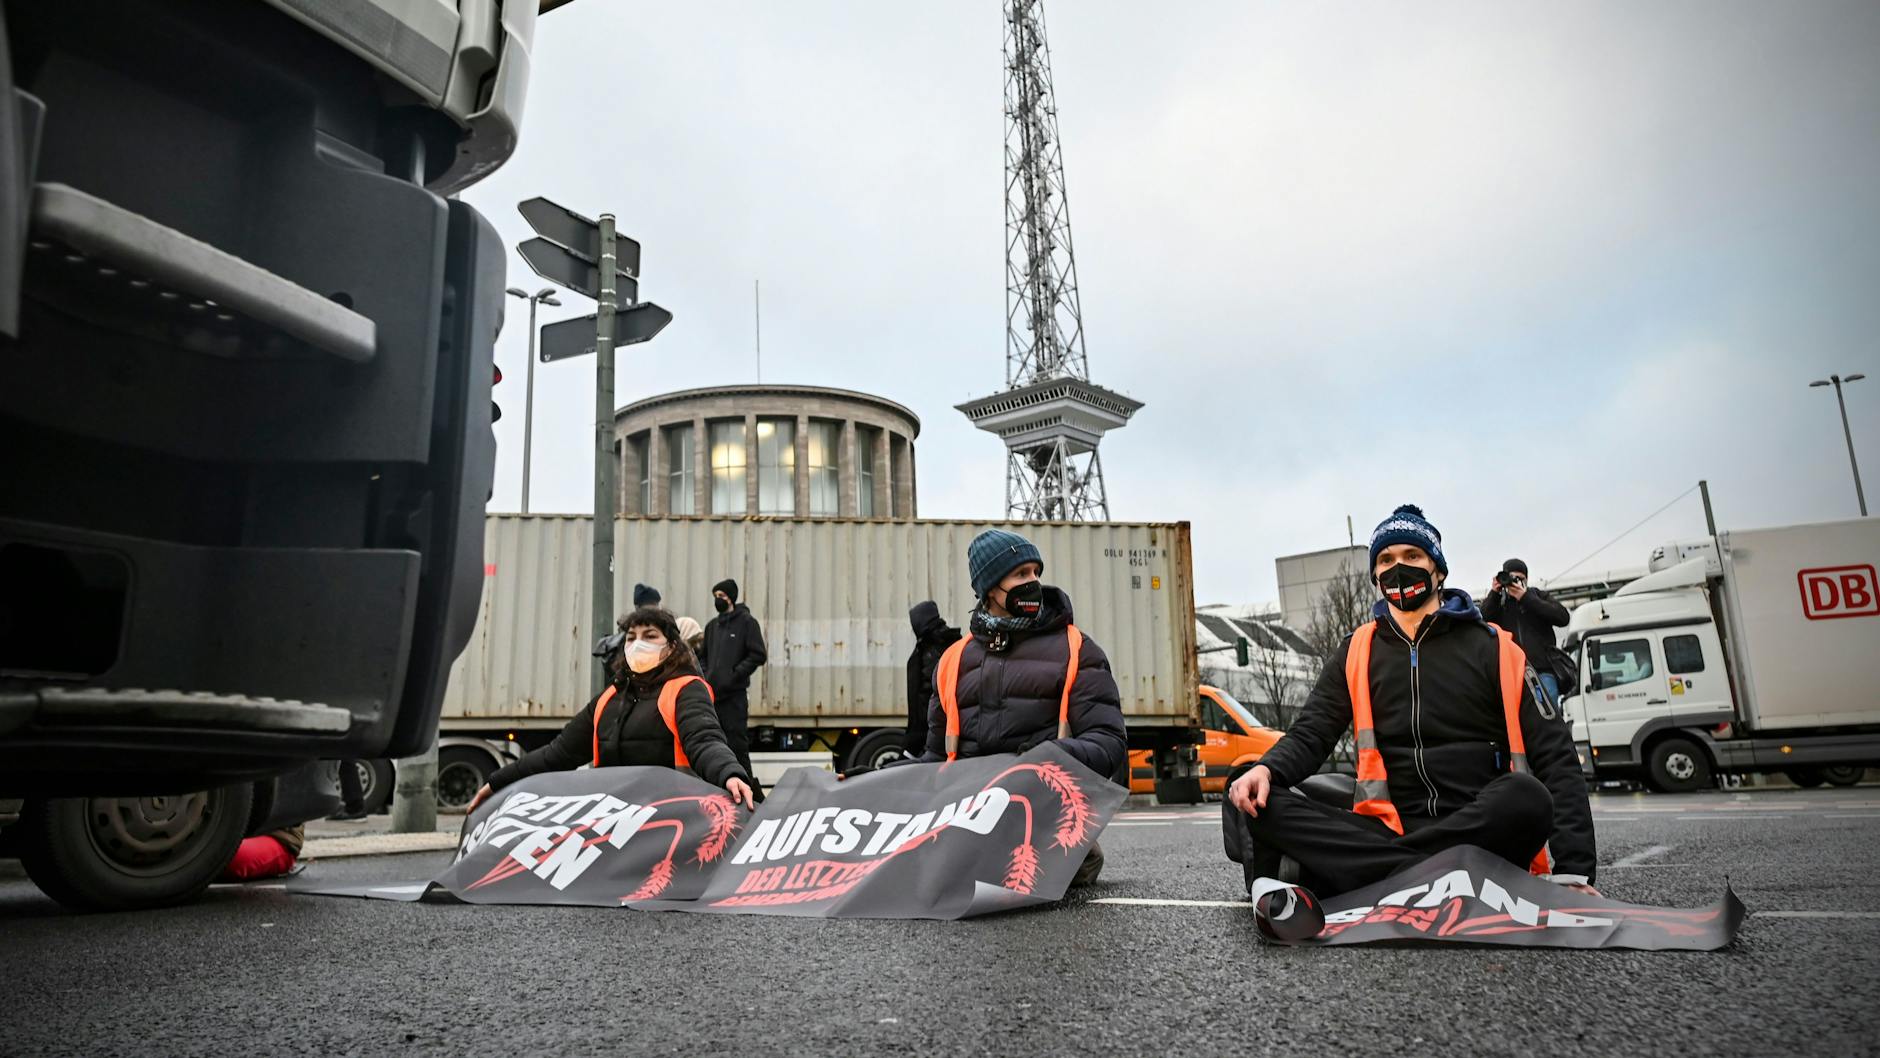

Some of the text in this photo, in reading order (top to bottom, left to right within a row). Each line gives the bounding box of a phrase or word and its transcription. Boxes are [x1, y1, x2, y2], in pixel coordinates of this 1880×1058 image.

[1808, 573, 1872, 611] DB
[731, 787, 1011, 865] AUFSTAND
[735, 866, 787, 894] DER
